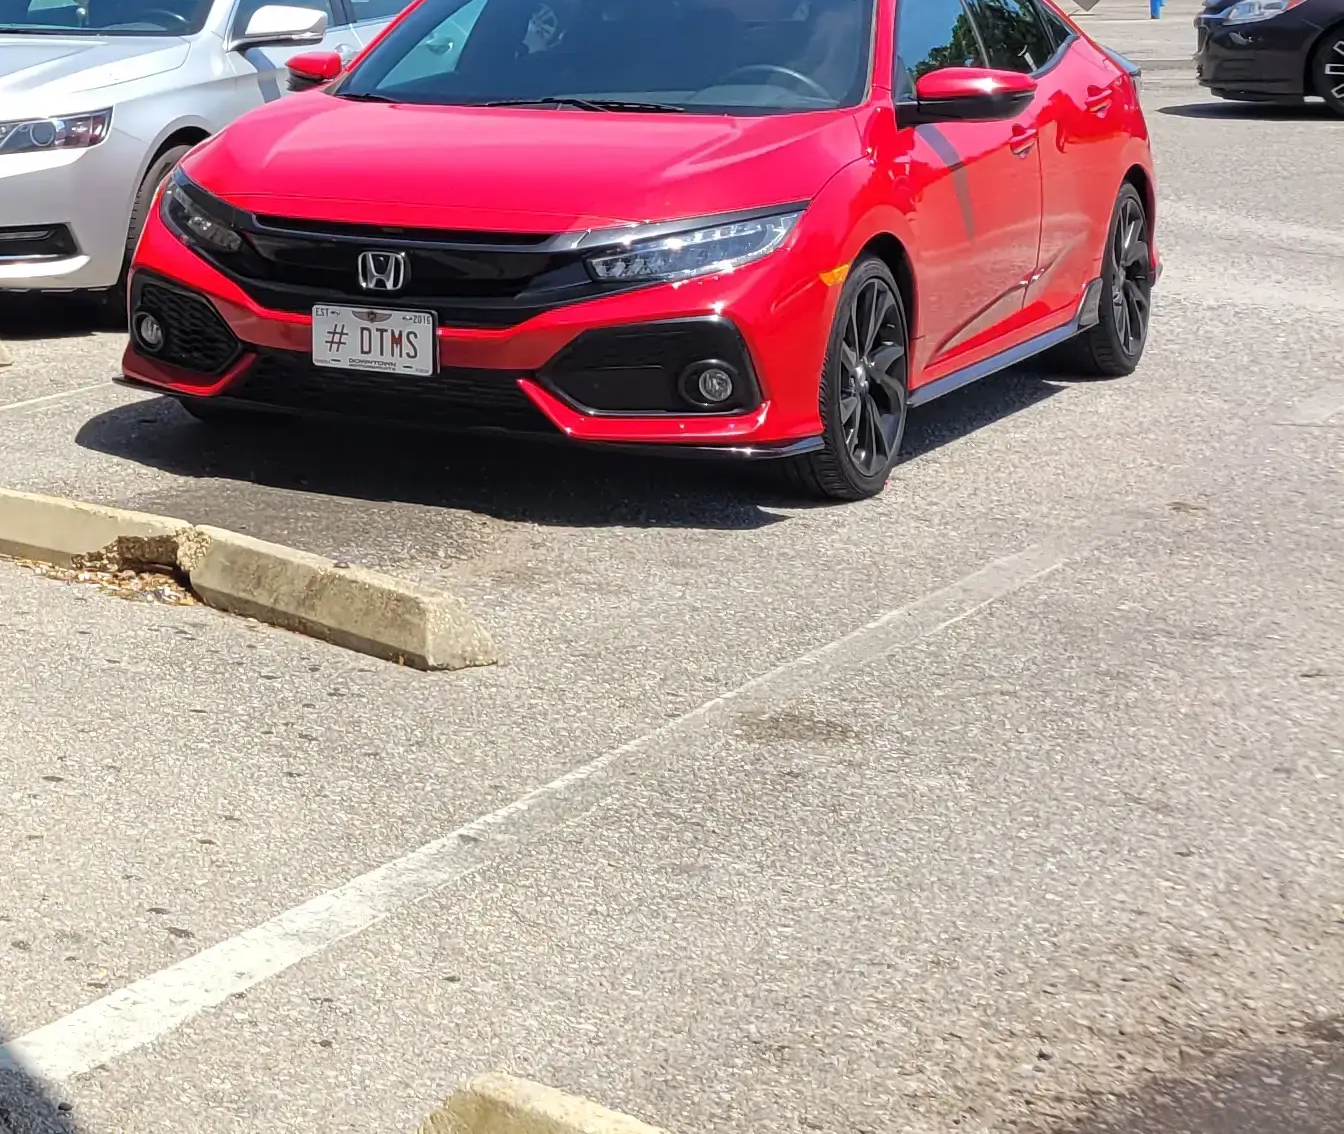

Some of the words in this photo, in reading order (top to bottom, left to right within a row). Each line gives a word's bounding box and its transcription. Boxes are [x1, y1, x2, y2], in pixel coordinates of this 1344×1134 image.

[315, 307, 330, 317] EST
[413, 314, 431, 325] 2016
[360, 327, 418, 359] DTMS
